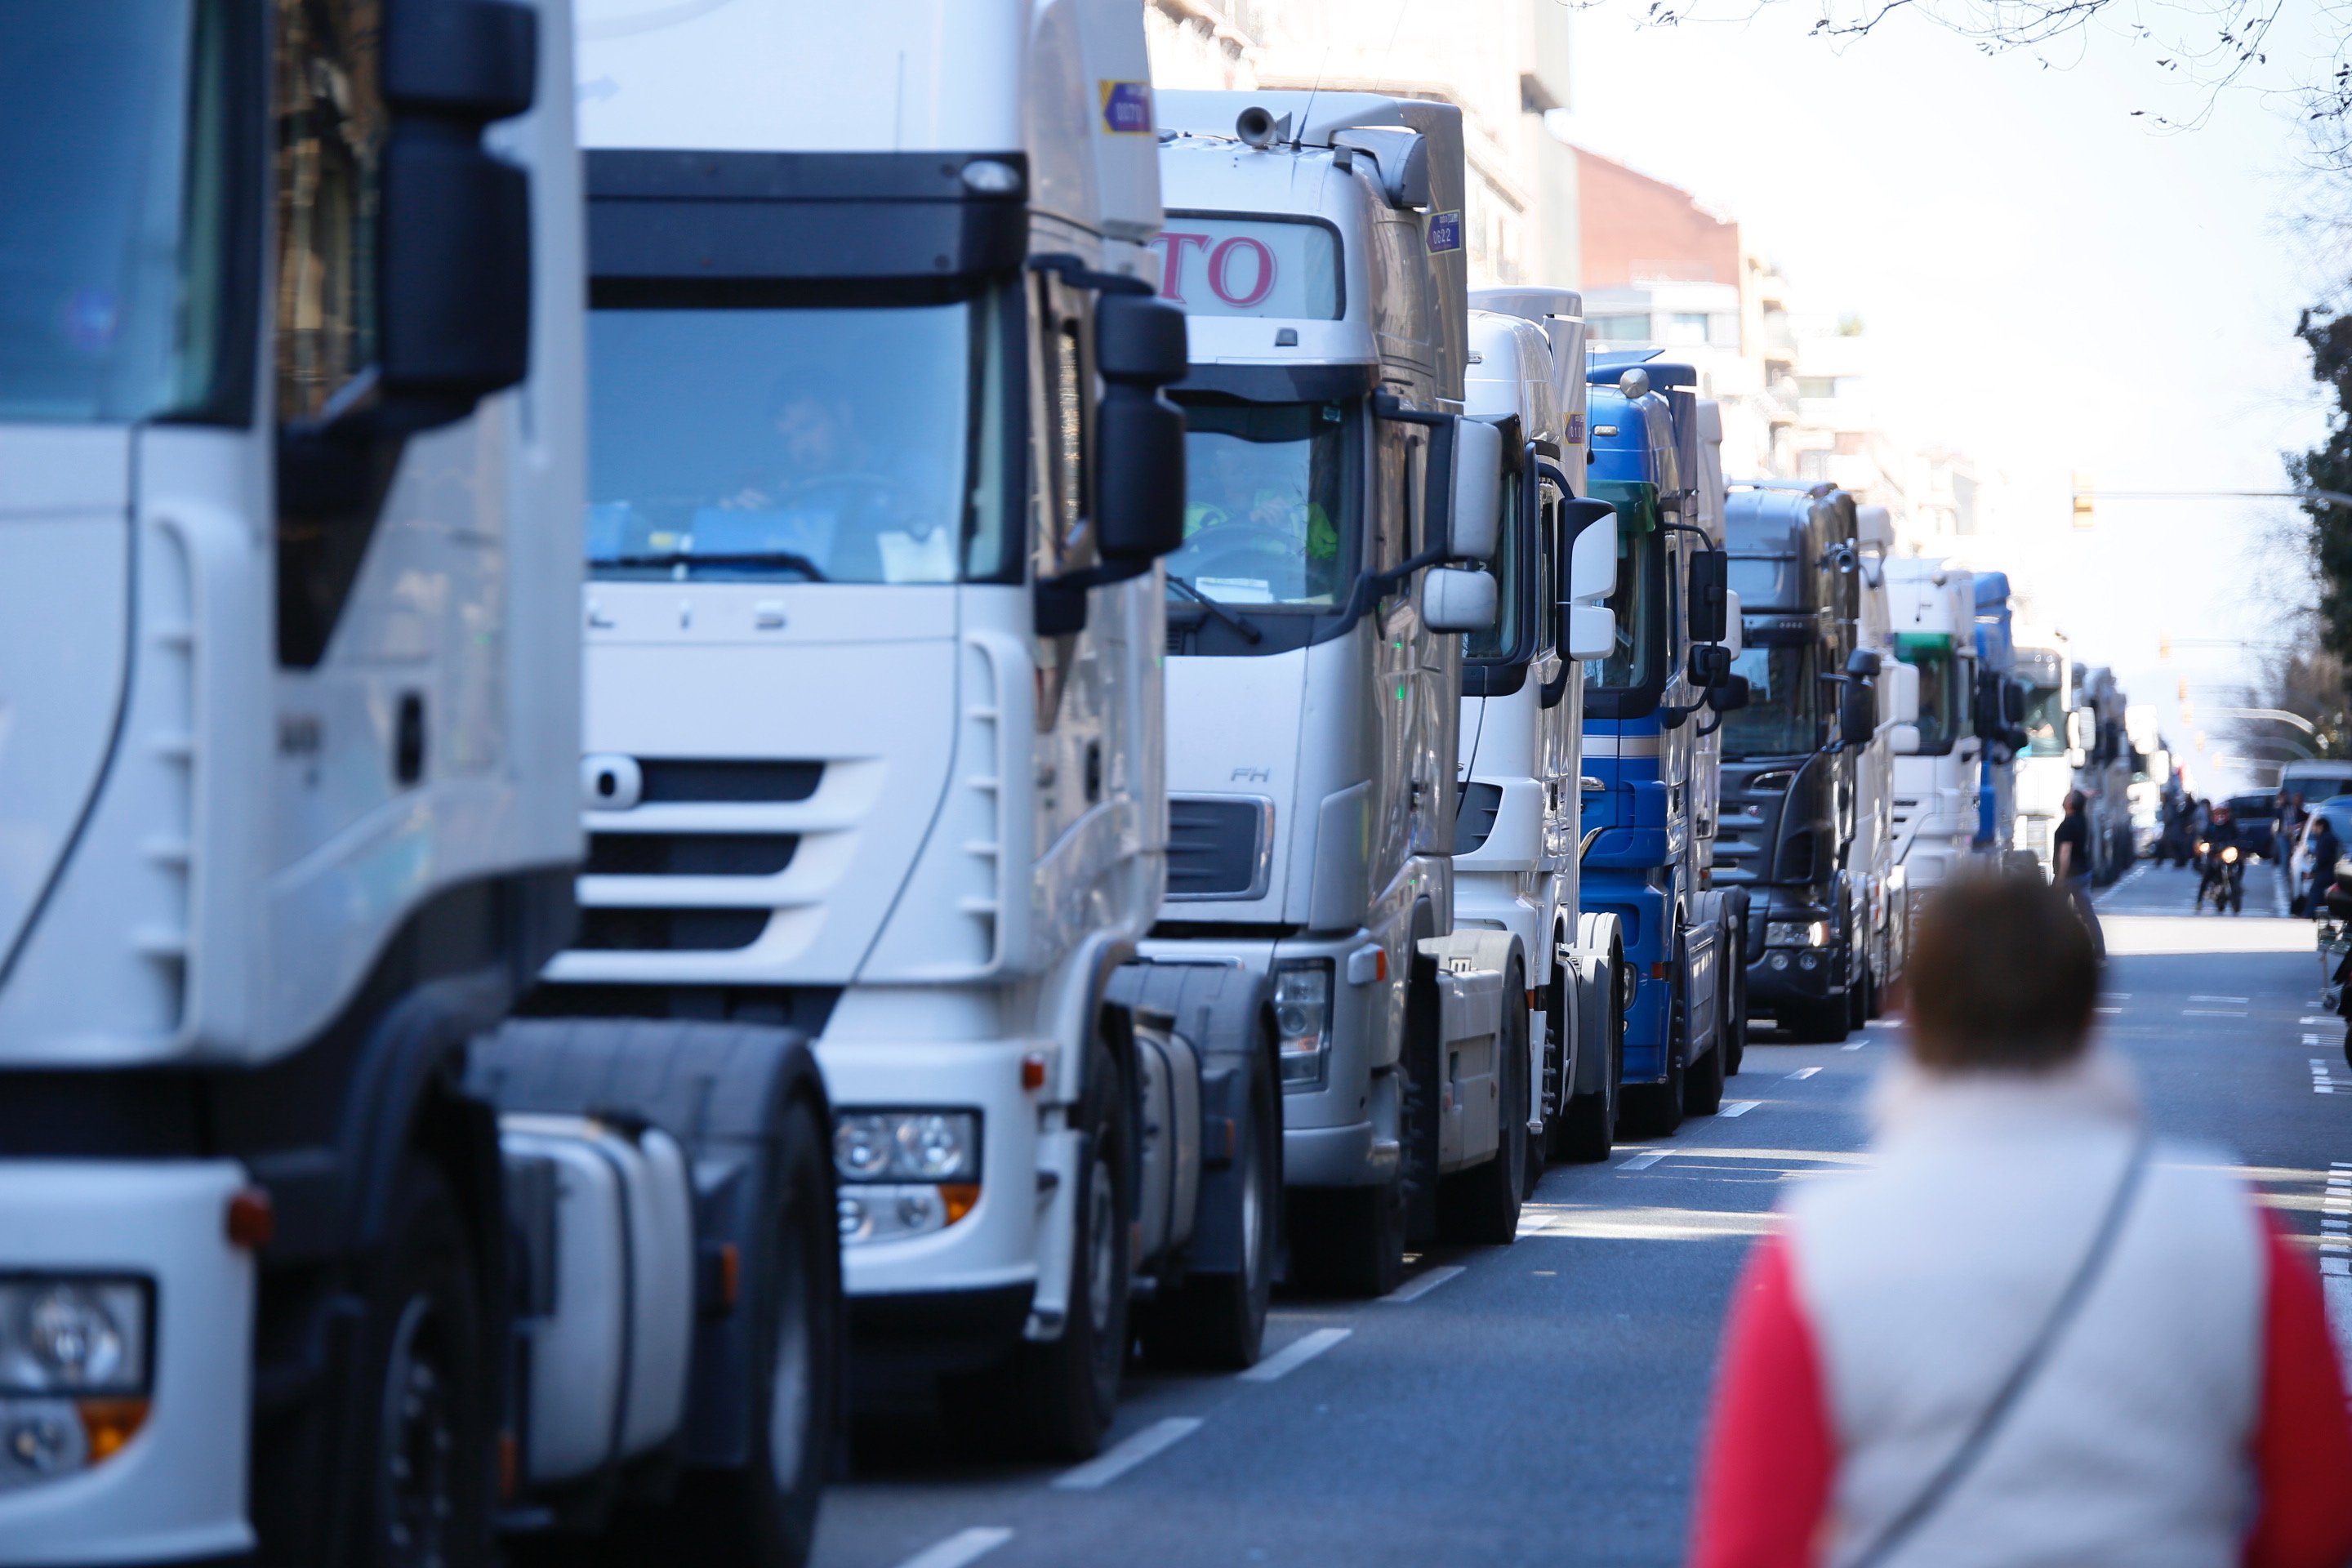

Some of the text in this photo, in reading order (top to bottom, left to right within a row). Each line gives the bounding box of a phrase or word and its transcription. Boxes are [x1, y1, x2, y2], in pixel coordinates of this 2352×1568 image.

[1432, 228, 1451, 244] 0622
[1151, 232, 1277, 308] TO
[1231, 768, 1270, 782] FH
